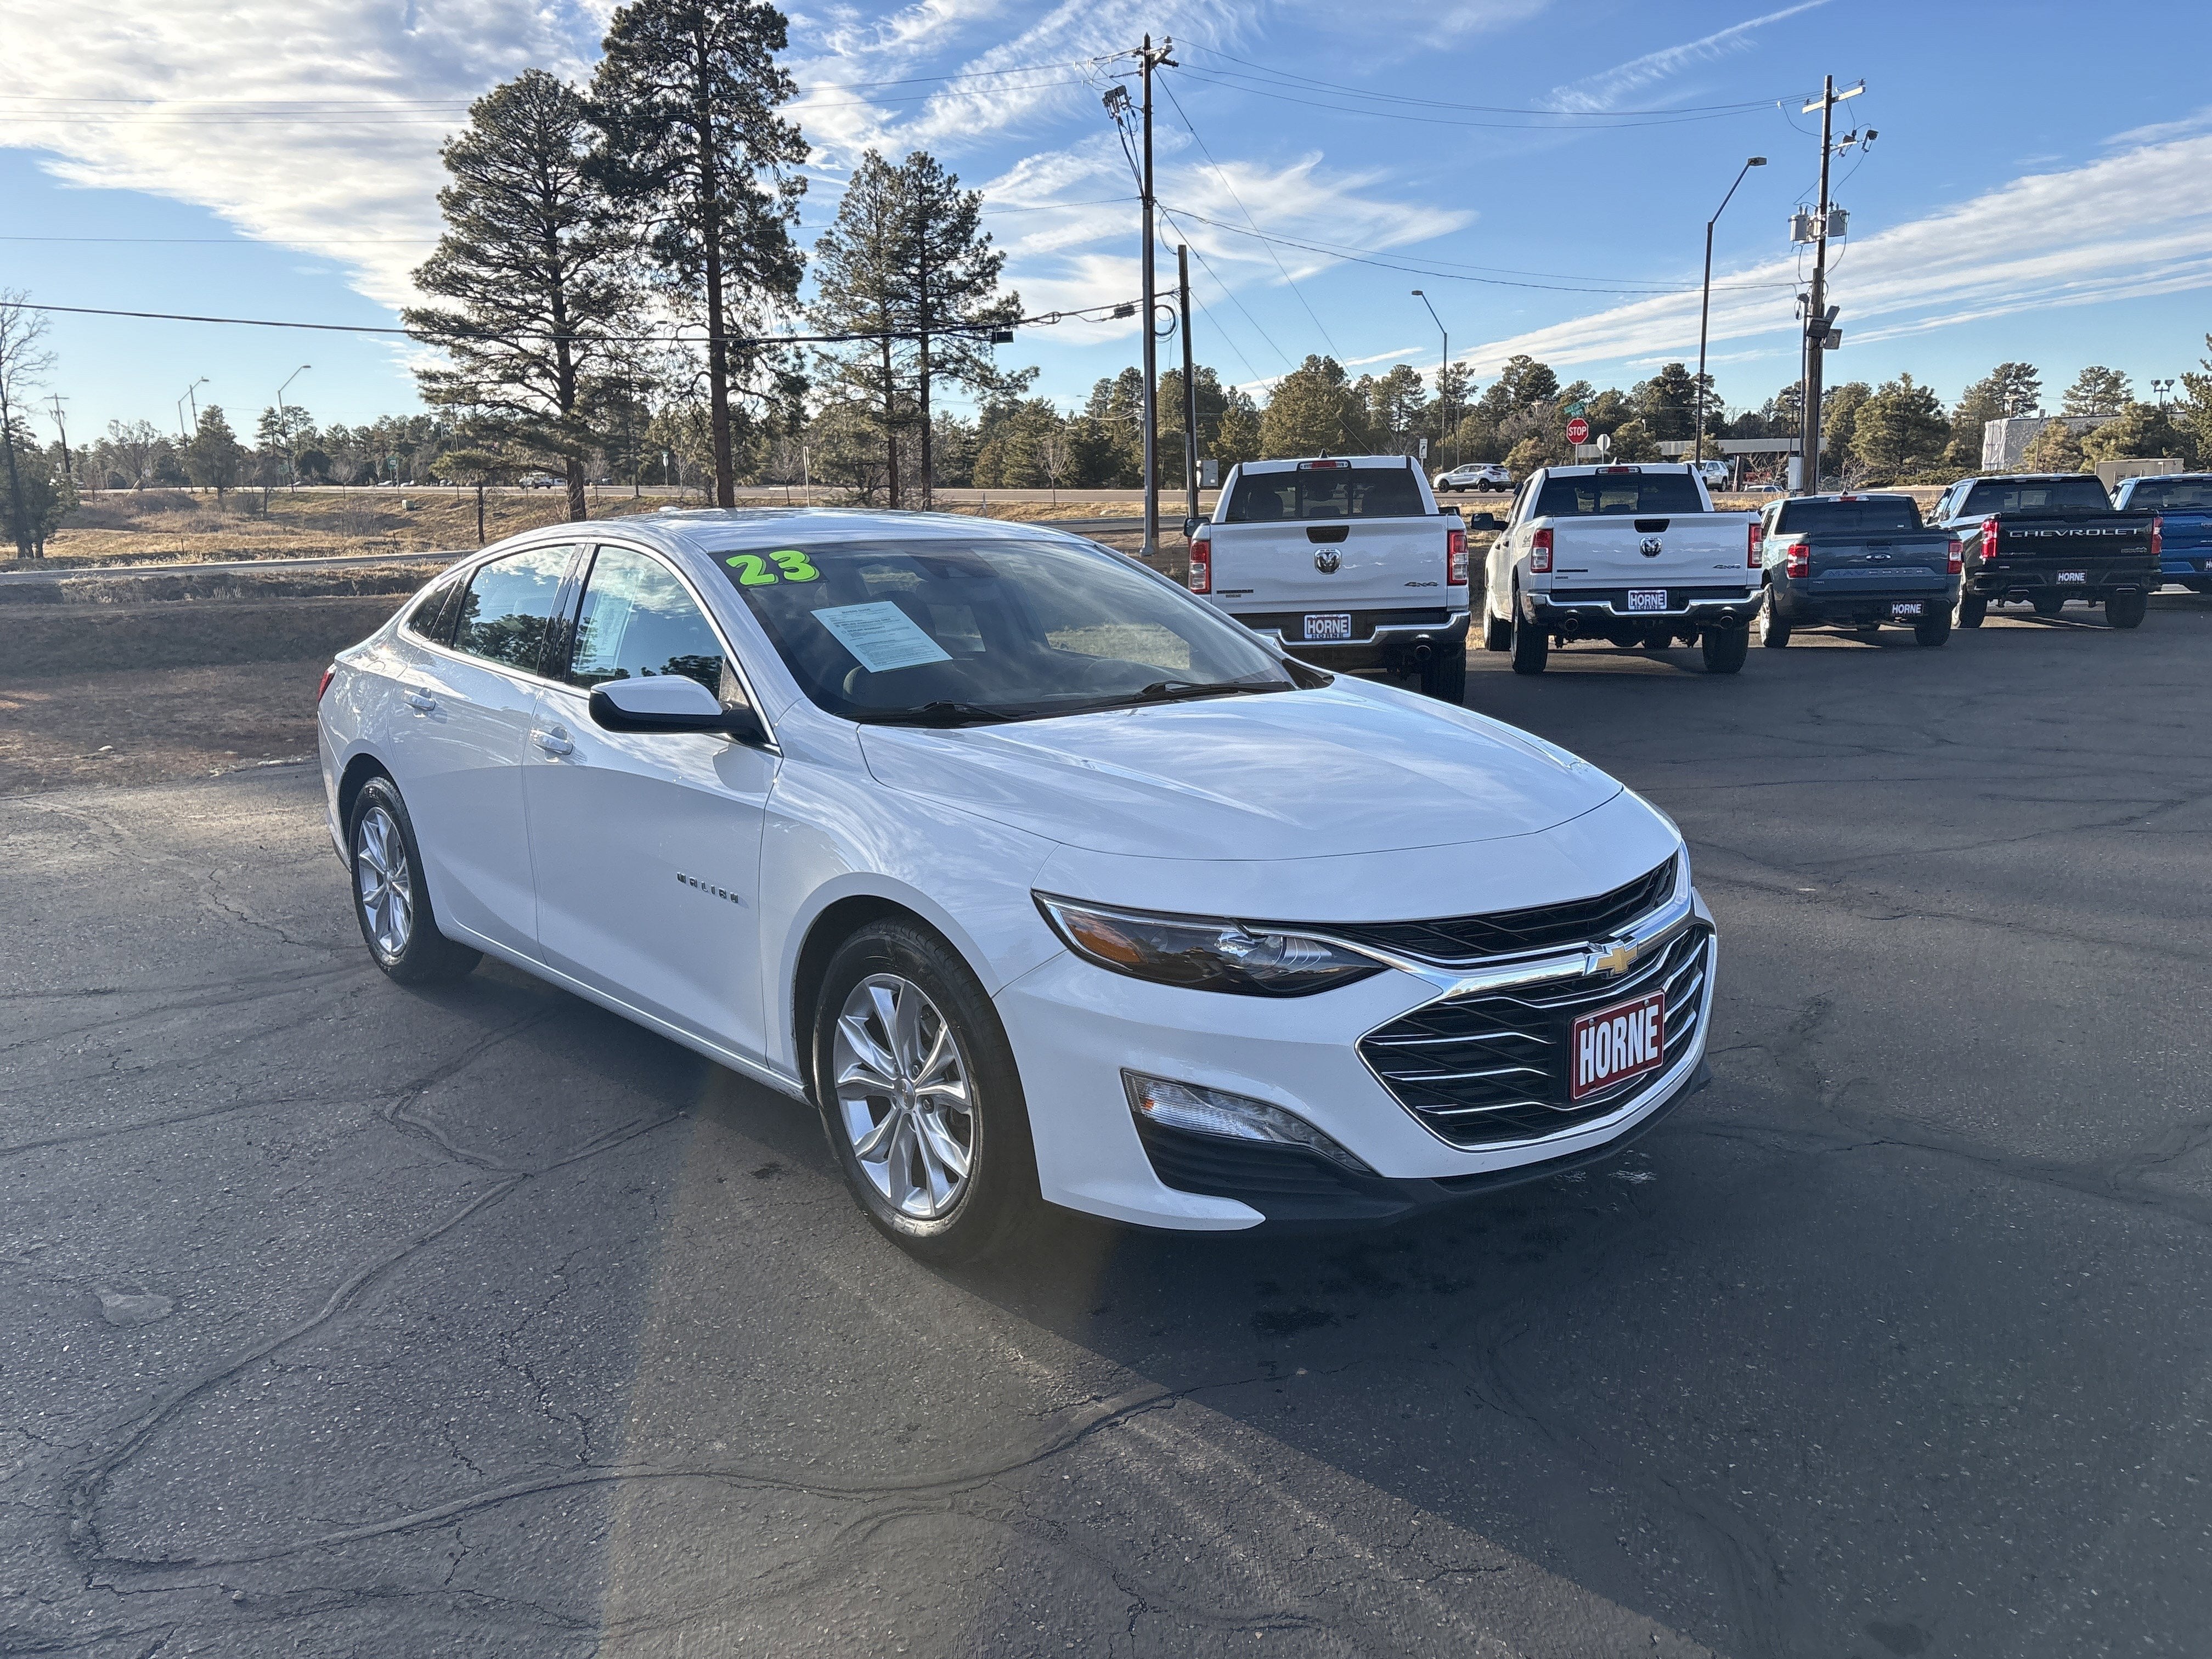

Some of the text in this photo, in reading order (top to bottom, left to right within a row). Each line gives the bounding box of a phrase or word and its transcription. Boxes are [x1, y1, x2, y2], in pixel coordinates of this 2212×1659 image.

[1568, 426, 1587, 437] STOP
[2010, 528, 2142, 538] CHEVROLET
[725, 550, 820, 586] 23
[2058, 573, 2085, 582] HORNE
[1630, 594, 1664, 606] HORNE
[1892, 603, 1922, 614] HORNE
[1307, 619, 1348, 634] HORNE
[676, 871, 738, 904] MALIBU
[1579, 1004, 1660, 1087] HORNE
